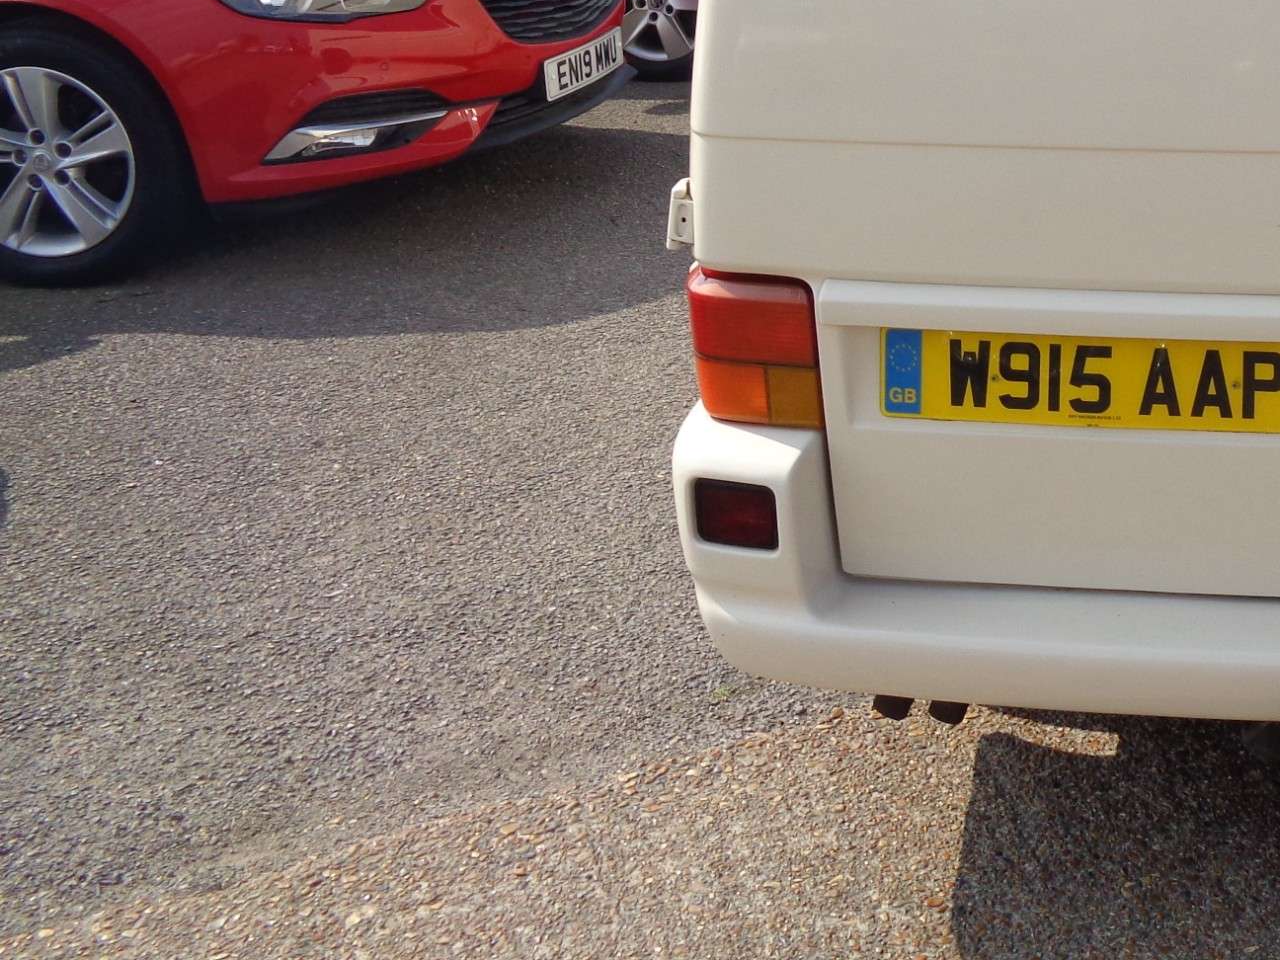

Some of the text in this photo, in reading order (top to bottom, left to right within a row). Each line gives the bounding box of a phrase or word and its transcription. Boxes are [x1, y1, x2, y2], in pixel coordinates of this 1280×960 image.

[557, 50, 593, 91] EN19
[888, 387, 917, 403] GB
[949, 338, 1112, 414] W915
